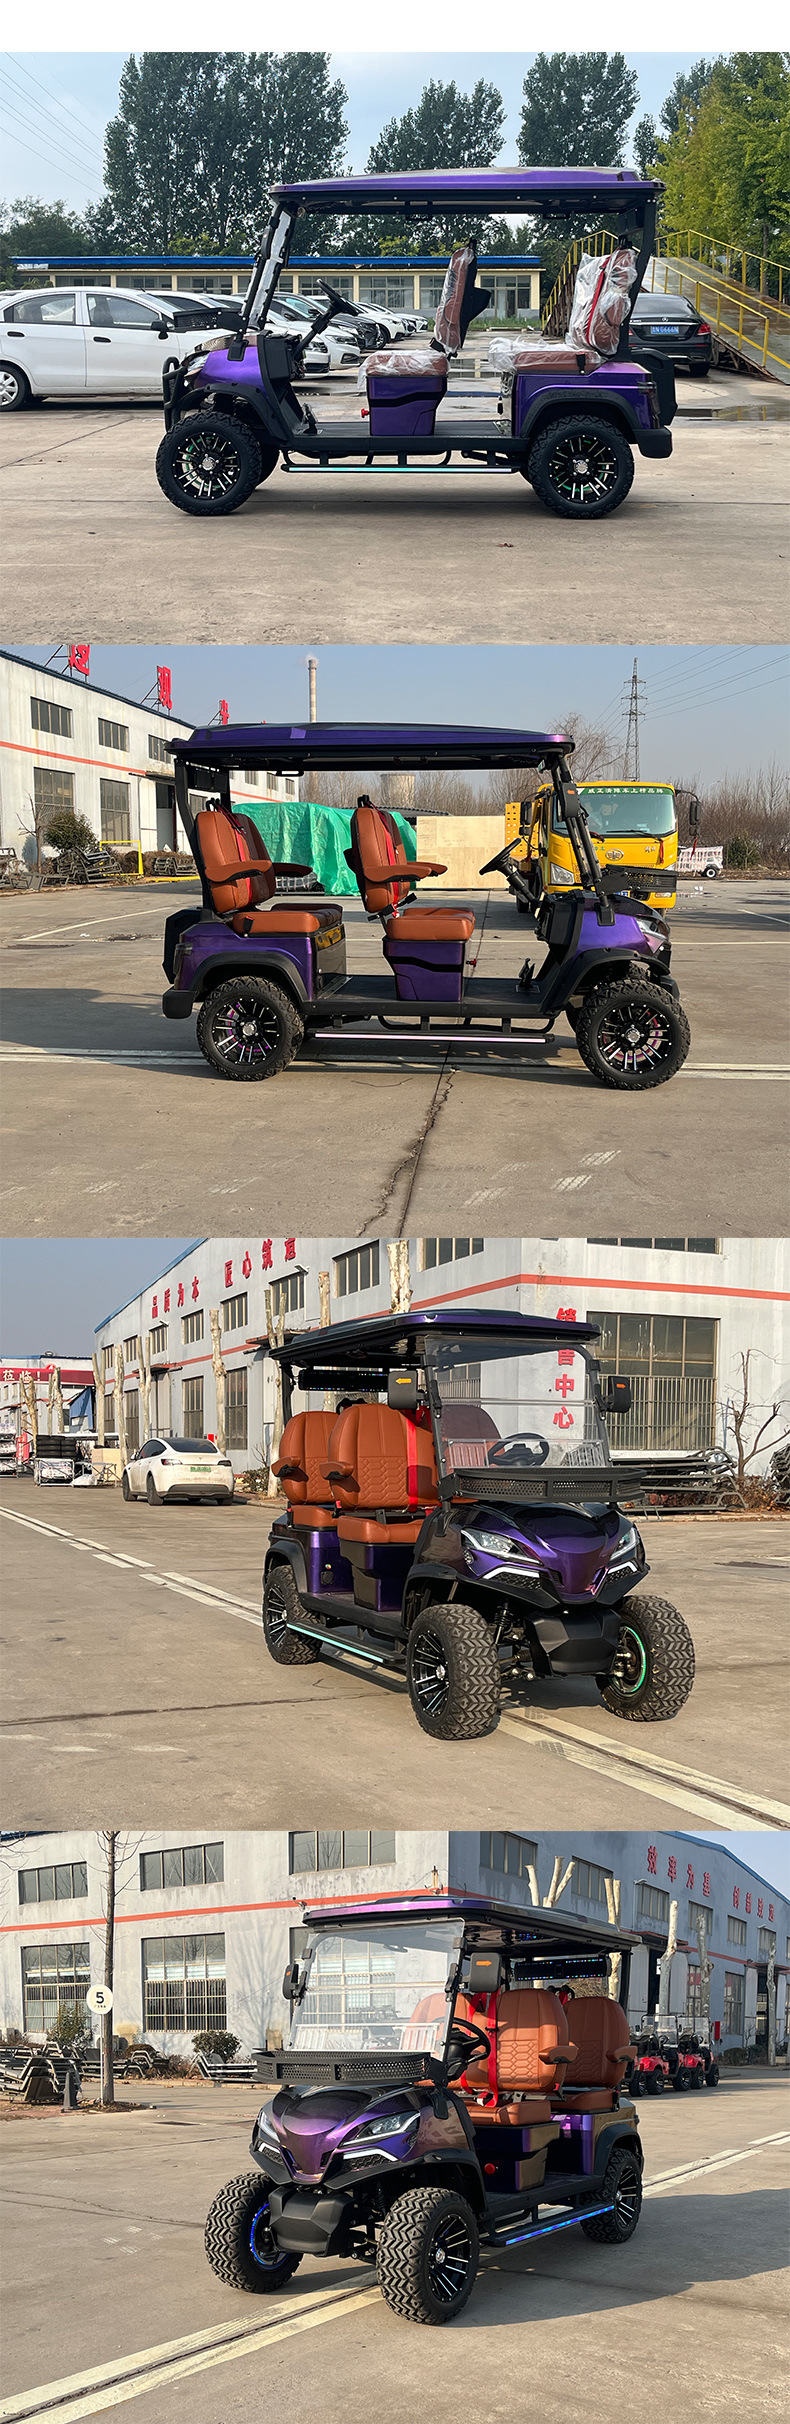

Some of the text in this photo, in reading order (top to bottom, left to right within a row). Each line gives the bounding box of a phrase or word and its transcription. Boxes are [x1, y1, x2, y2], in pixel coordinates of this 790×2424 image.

[152, 1275, 200, 1319] 品质为本
[647, 1845, 711, 1897] 效率为基
[96, 1992, 104, 2004] 5
